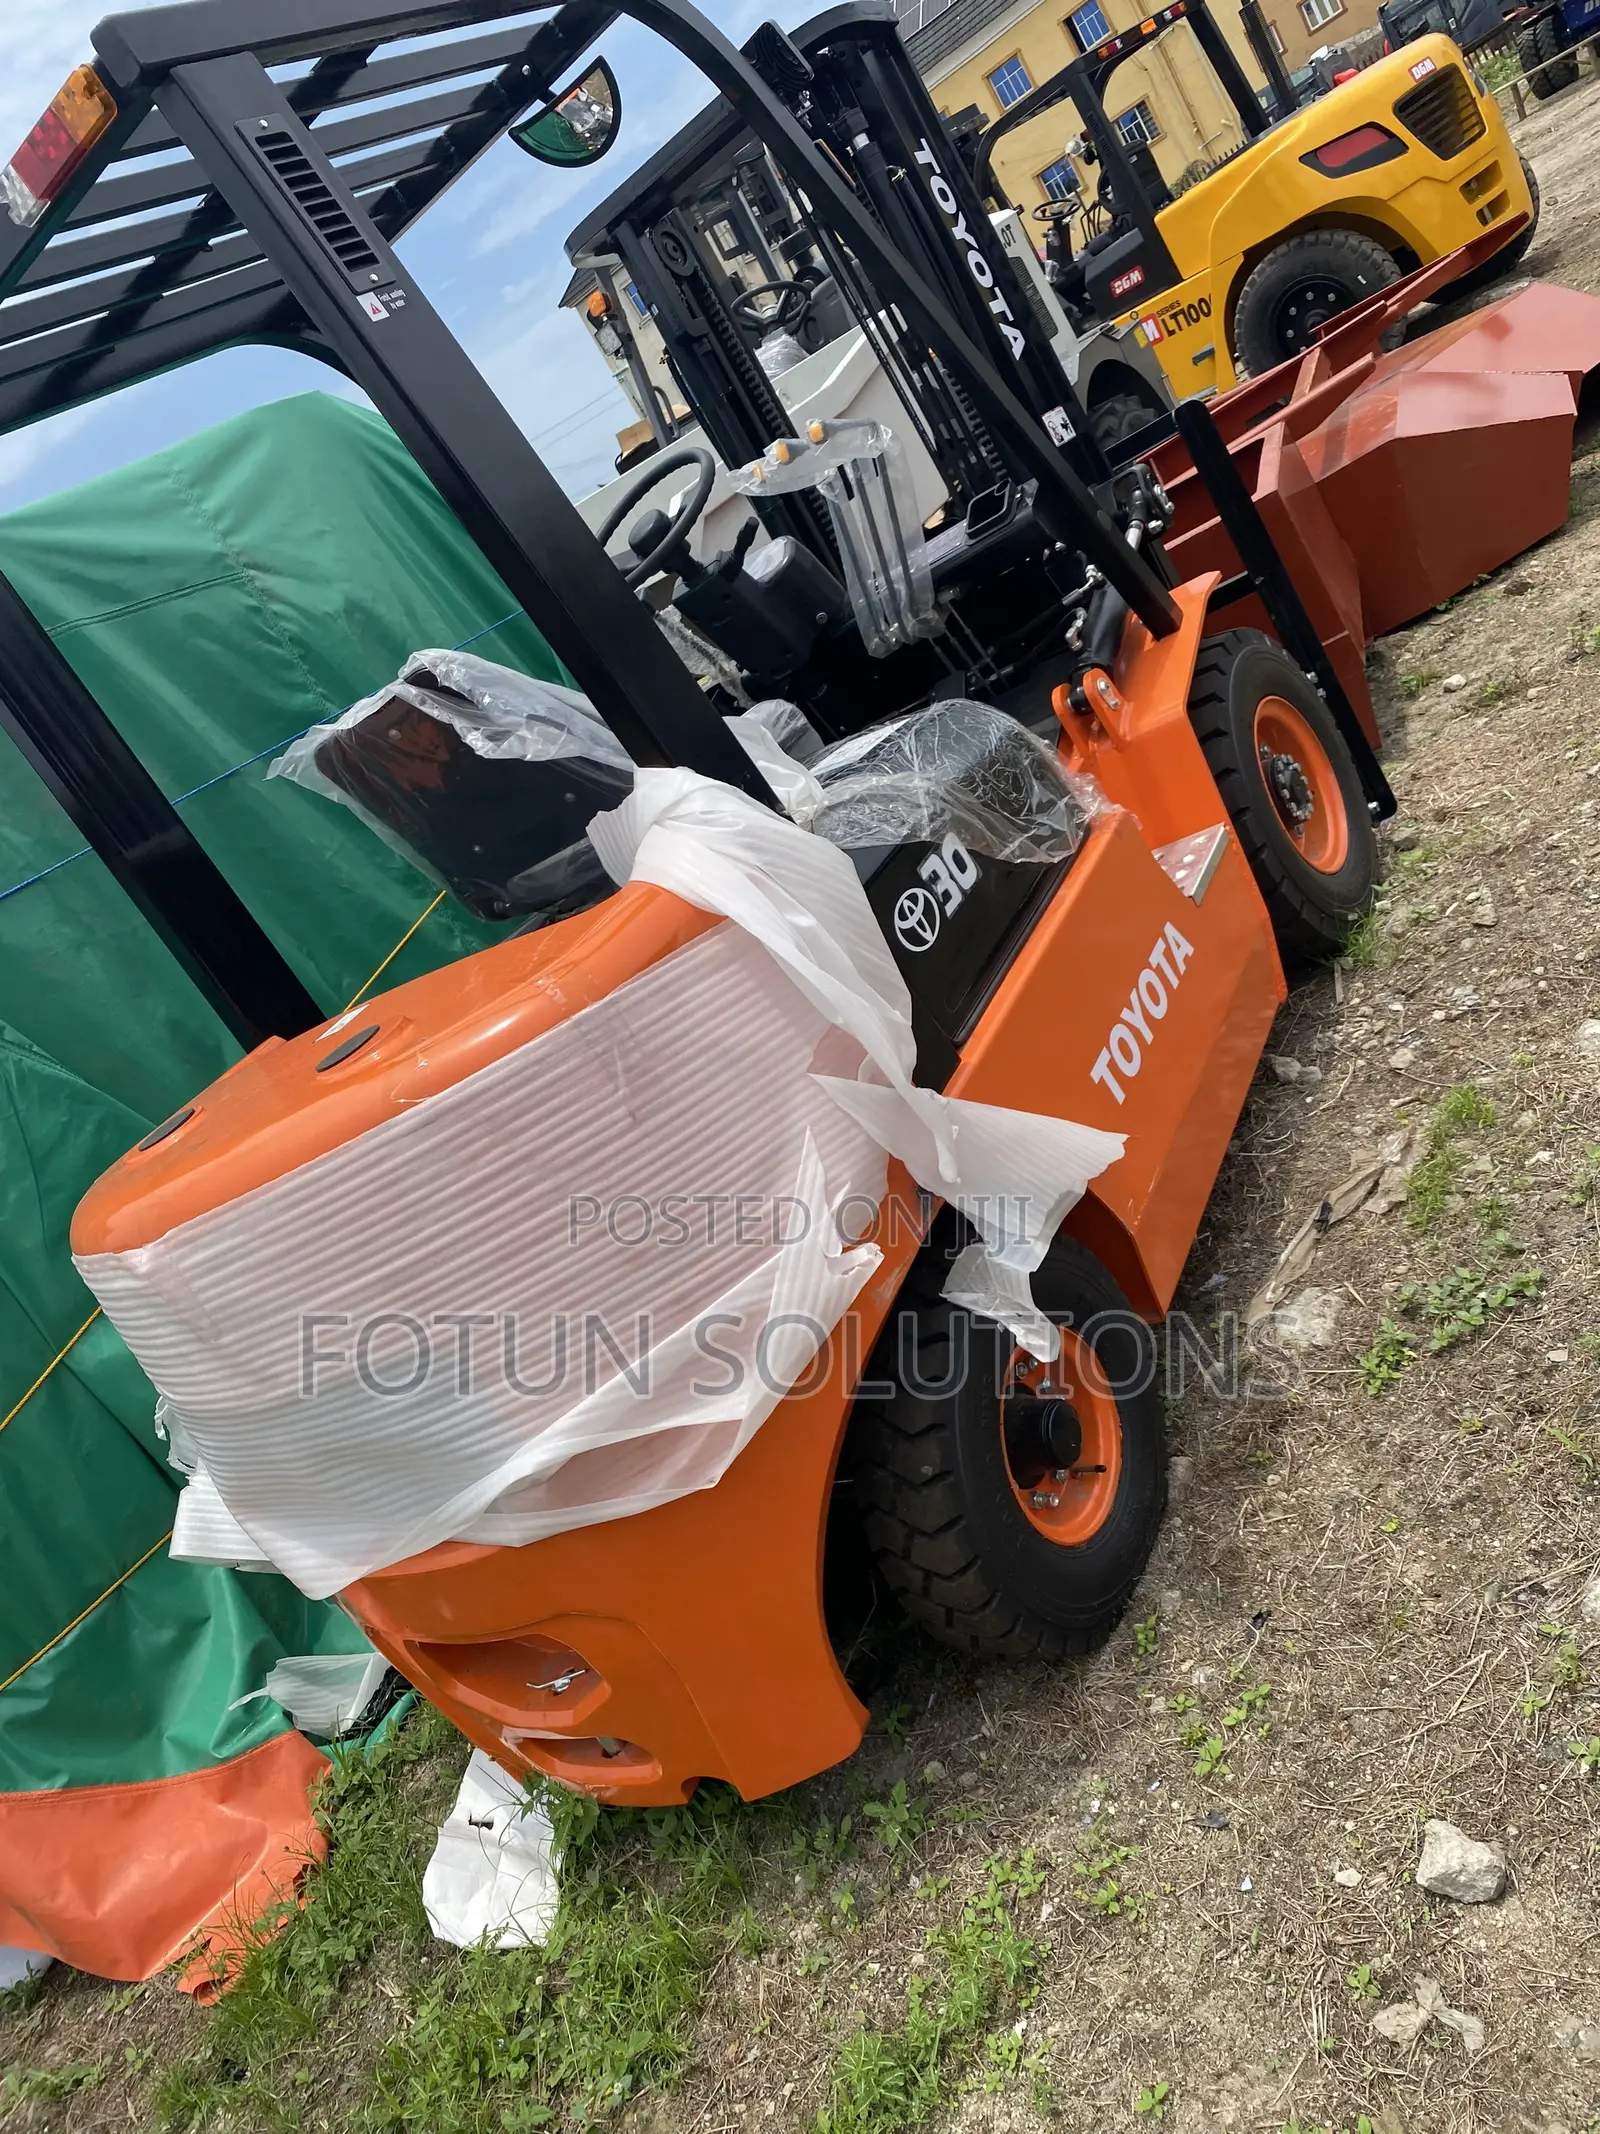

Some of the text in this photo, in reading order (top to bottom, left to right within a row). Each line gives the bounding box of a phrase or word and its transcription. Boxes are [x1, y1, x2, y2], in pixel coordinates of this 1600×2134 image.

[1411, 58, 1436, 80] DGM
[914, 138, 1026, 361] TOYOTA
[1001, 224, 1016, 249] OT
[1156, 300, 1182, 318] SERIES
[1160, 293, 1212, 337] LT100
[920, 831, 978, 918] 30
[1090, 921, 1195, 1106] TOYOTA
